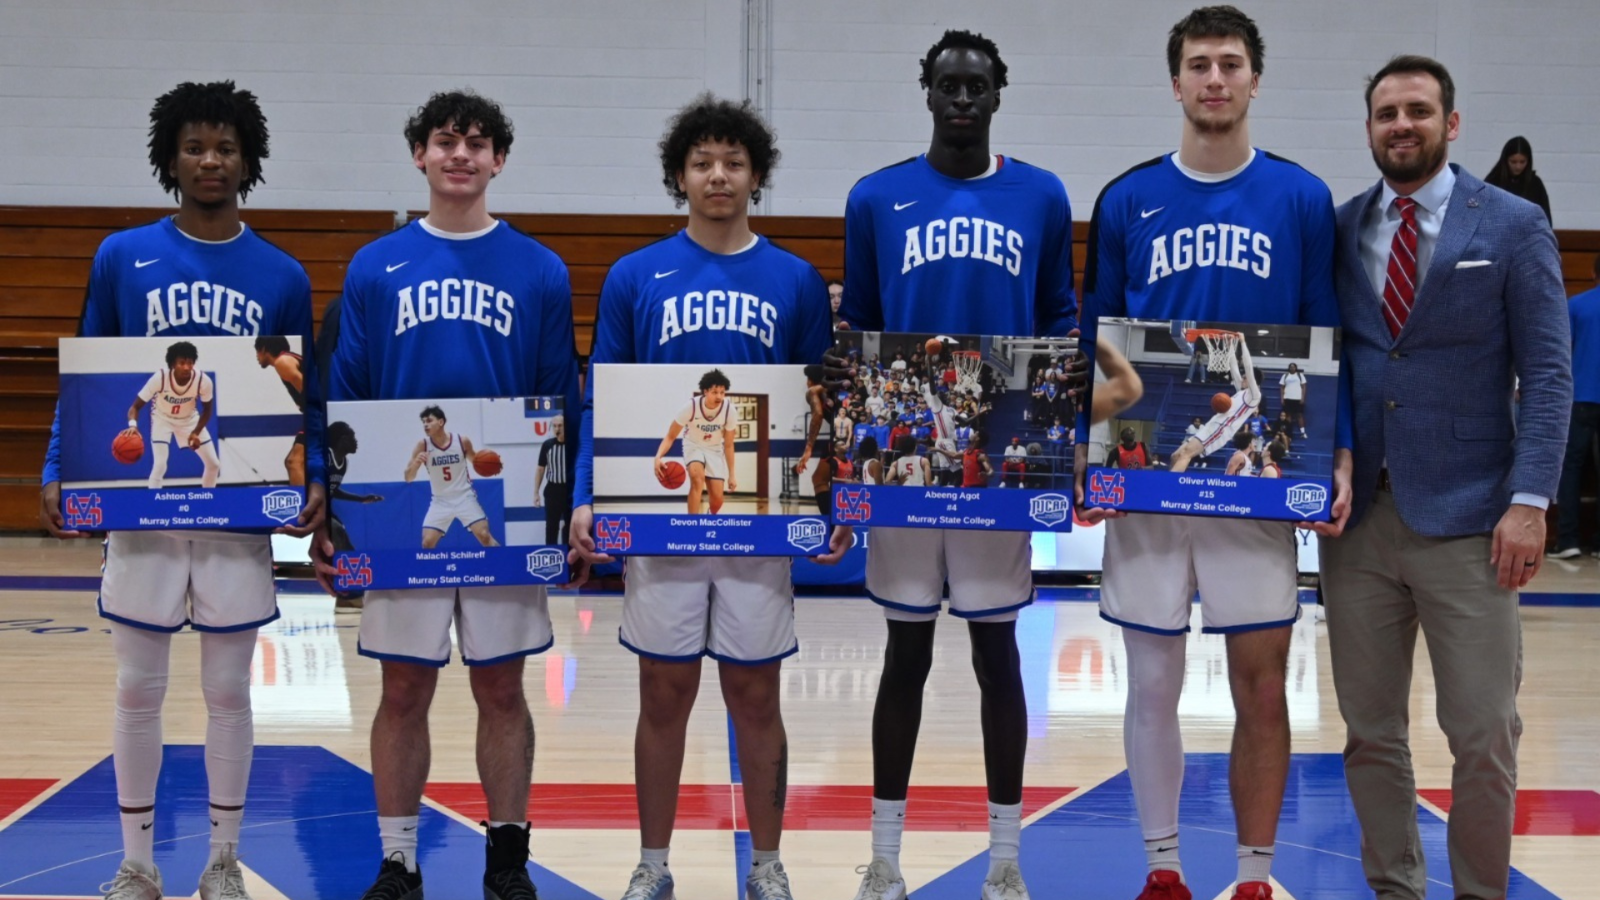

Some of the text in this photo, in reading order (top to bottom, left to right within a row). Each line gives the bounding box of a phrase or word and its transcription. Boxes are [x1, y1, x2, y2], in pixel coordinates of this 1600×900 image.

[901, 216, 1024, 278] AGGIES
[1147, 222, 1272, 285] AGGIES
[145, 281, 264, 337] AGGIES
[394, 278, 515, 337] AGGIES
[658, 289, 778, 349] AGGIES
[431, 454, 460, 466] AGGIES
[442, 467, 452, 482] 5
[905, 463, 914, 475] 5
[1178, 476, 1237, 488] Oliver Wilson
[154, 491, 214, 501] Ashton Smith
[924, 490, 980, 502] Abeeng Agot
[1198, 490, 1215, 499] #15
[1287, 488, 1326, 506] NJCAA
[178, 504, 190, 513] #0
[263, 495, 301, 512] NJCAA
[946, 503, 958, 512] #4
[1031, 499, 1067, 515] NJCAA
[1160, 500, 1251, 515] Murray State College
[139, 516, 230, 527] Murray State College
[670, 518, 752, 527] Devon MacCollister
[907, 514, 996, 527] Murray State College
[706, 530, 717, 539] #2
[789, 524, 825, 541] NJCAA
[667, 542, 755, 553] Murray State College
[415, 550, 486, 560] Malachi Schilreff
[446, 563, 457, 572] #5
[528, 554, 564, 571] NJCAA
[408, 575, 495, 586] Murray State College
